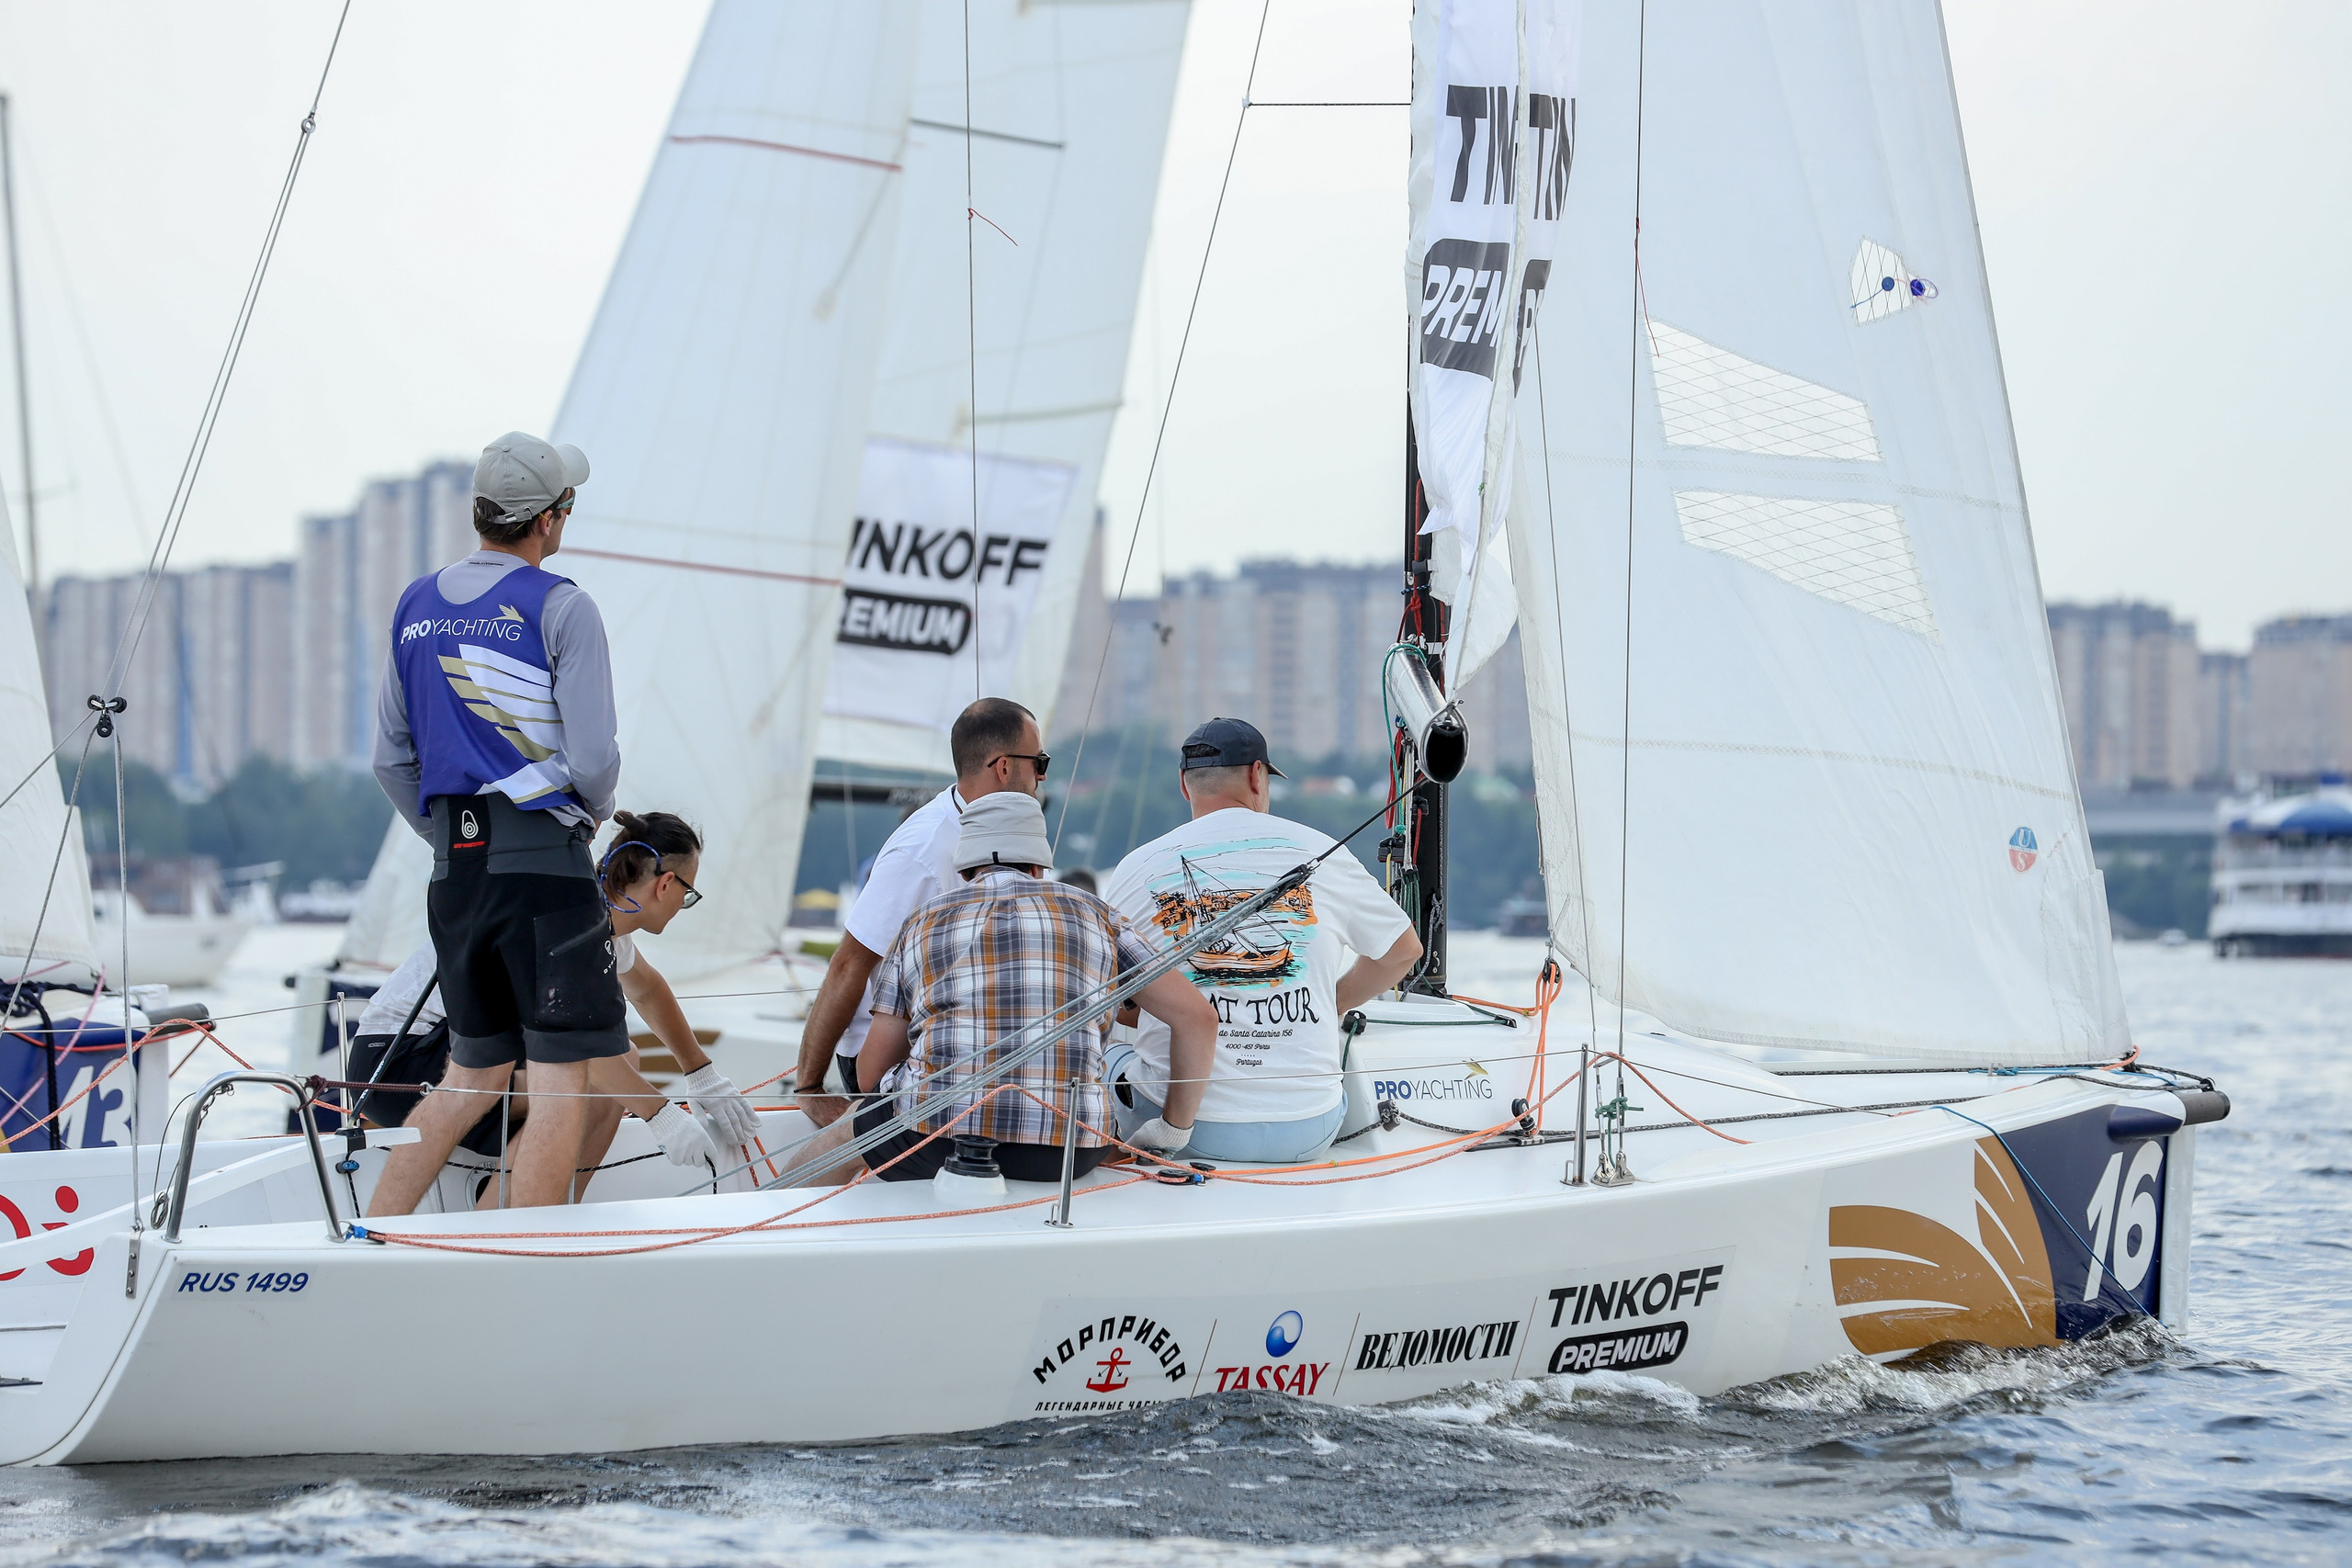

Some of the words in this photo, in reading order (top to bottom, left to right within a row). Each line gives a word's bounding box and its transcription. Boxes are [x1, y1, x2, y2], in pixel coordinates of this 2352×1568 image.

[401, 618, 523, 645] PROYACHTING
[1246, 987, 1319, 1024] TOUR
[1218, 1029, 1229, 1037] de
[1229, 1029, 1250, 1038] Santa
[1251, 1030, 1281, 1038] Catarina
[1281, 1029, 1294, 1037] 156
[1236, 1058, 1264, 1066] Portugal
[1374, 1078, 1493, 1100] PROYACHTING
[2083, 1140, 2164, 1303] 16
[177, 1272, 240, 1292] RUS
[244, 1272, 309, 1292] 1499
[1548, 1265, 1724, 1328] TINKOFF
[1033, 1315, 1186, 1384] МОРПРИБОР
[1354, 1320, 1521, 1373] ВЕДОМОСТИ
[1555, 1328, 1682, 1372] PREMIUM
[1214, 1362, 1331, 1396] TASSAY
[1035, 1401, 1124, 1413] ЛЕГЕНДАРНЫЕ
